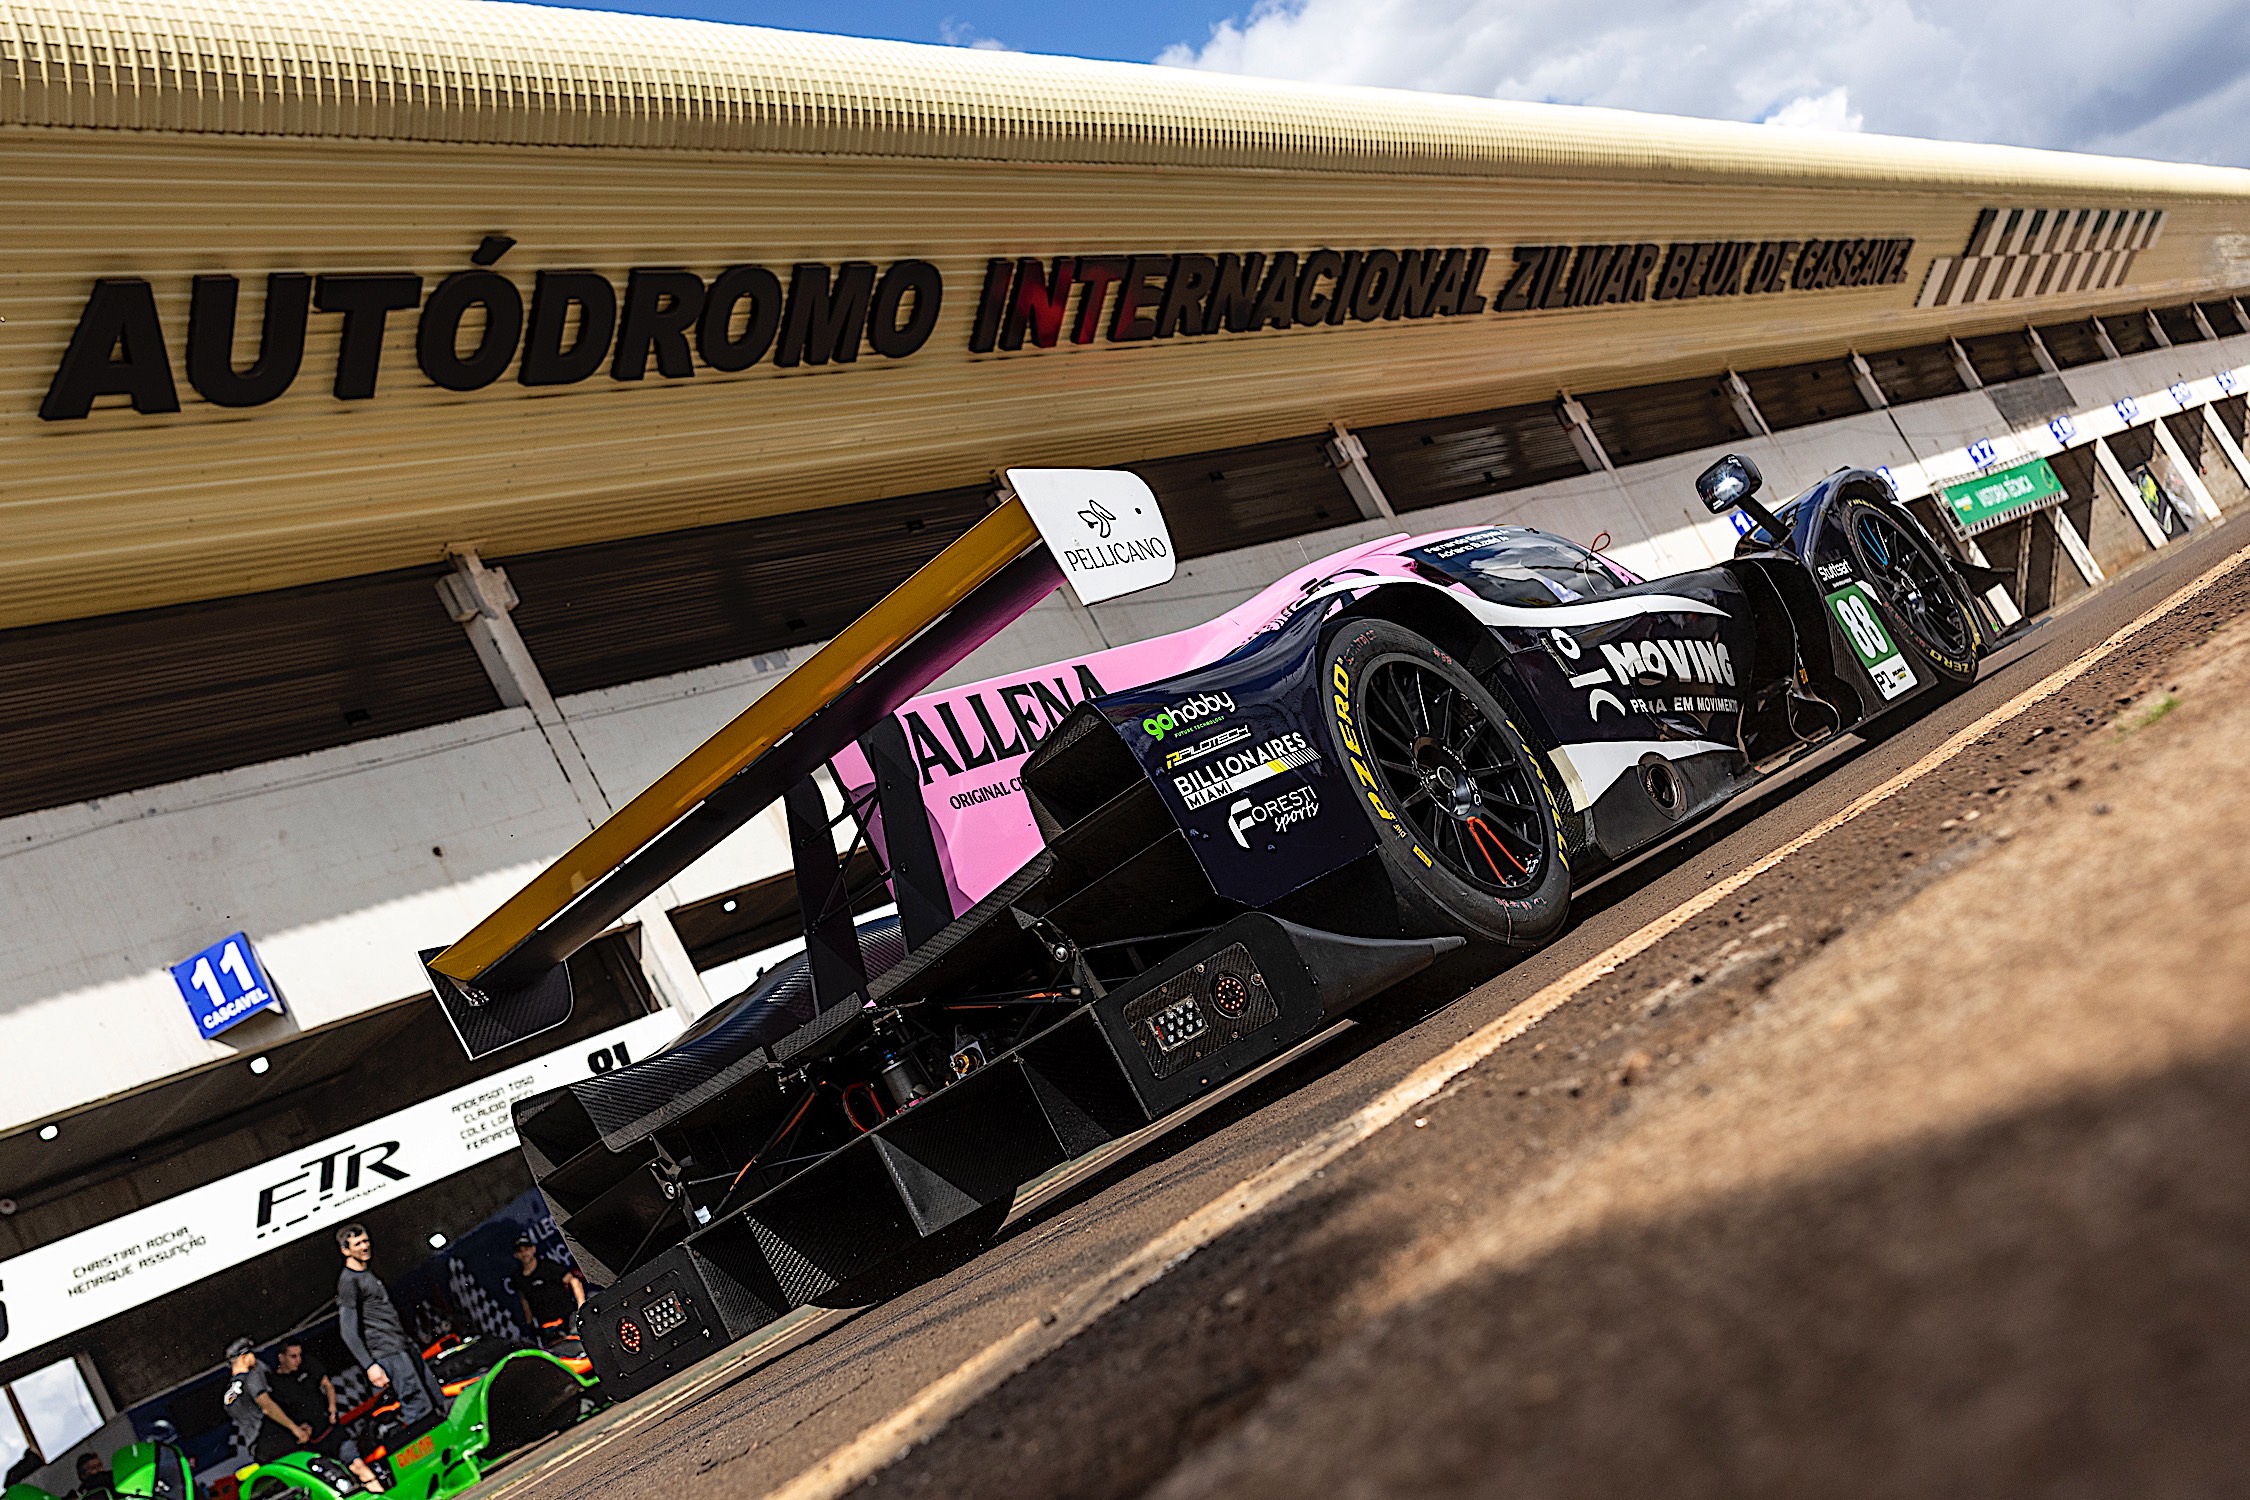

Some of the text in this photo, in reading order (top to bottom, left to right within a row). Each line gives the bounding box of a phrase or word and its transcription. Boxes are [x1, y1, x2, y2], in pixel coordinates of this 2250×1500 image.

[38, 236, 1915, 421] AUTÓDROMO INTERNACIONAL ZILMAR BEUX DE CASCAVEL
[1969, 439, 1993, 464] 17
[1063, 537, 1167, 572] PELLICANO
[1836, 595, 1888, 659] 88
[1599, 639, 1736, 687] MOVING
[1874, 670, 1897, 693] P1
[1143, 691, 1236, 741] gohobby
[1674, 697, 1694, 712] EM
[1174, 715, 1225, 738] FUTURE TECHNOLOGY
[1173, 732, 1307, 797] BILLIONAIRES
[949, 781, 1011, 810] ORIGINAL
[1186, 780, 1234, 809] MIAMI
[1228, 785, 1318, 848] FORESTI
[1274, 802, 1320, 832] sports
[191, 941, 256, 1008] 11
[203, 987, 269, 1029] CASCAVEL
[451, 1075, 535, 1114] ANDERSON TOSO
[460, 1123, 487, 1140] COLE
[466, 1126, 516, 1151] FERNAND
[256, 1140, 412, 1229] FTR
[67, 1234, 207, 1299] HENRIQUE ASSUNÇÃO
[72, 1226, 191, 1280] CHRISTIAN ROCHA
